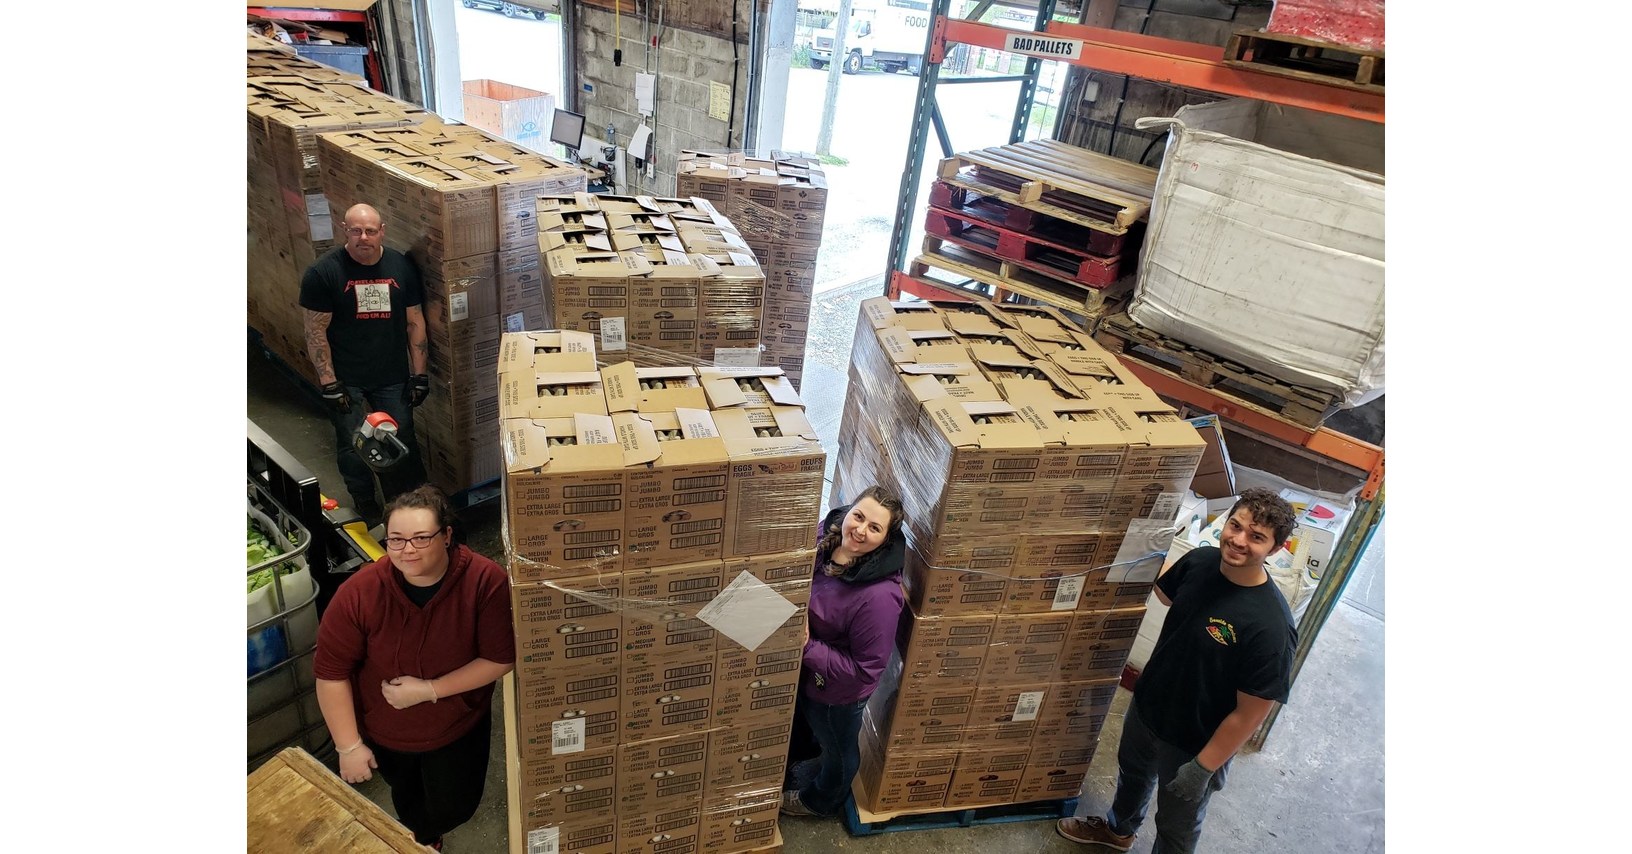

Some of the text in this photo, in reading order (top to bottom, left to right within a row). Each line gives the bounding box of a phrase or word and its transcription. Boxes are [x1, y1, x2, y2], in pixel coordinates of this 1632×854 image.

[904, 16, 928, 28] FOOD
[1013, 37, 1073, 55] BAD PALLETS
[800, 457, 823, 466] OEUFS
[733, 464, 753, 473] EGGS
